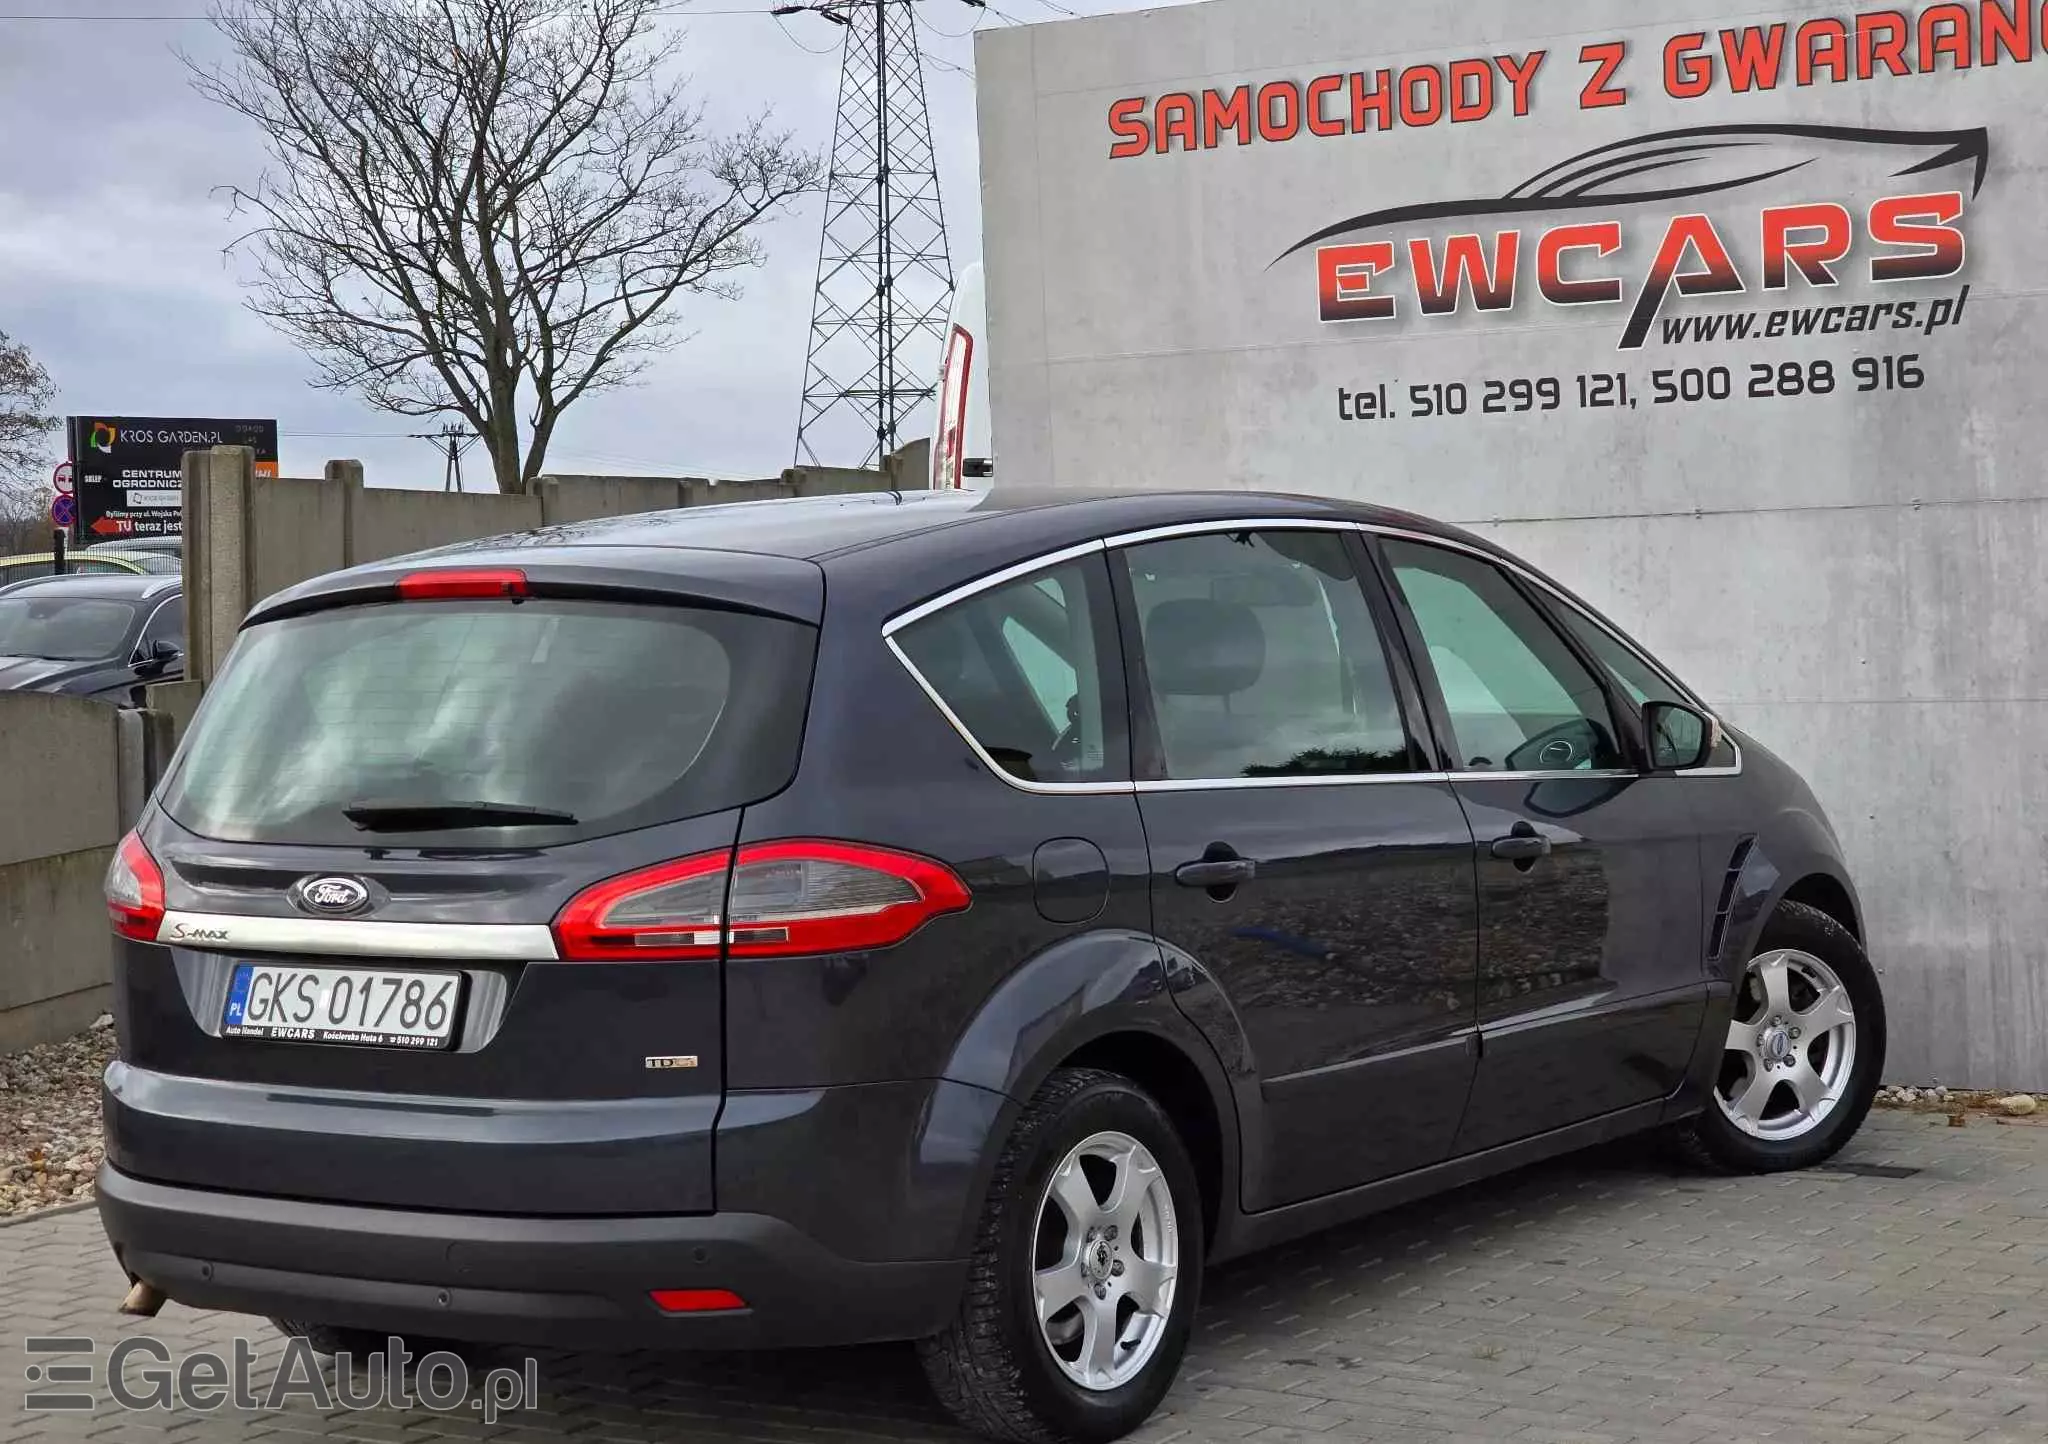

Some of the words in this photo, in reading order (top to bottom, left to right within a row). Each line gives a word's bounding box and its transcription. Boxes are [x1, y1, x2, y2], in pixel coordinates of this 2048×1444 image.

[1108, 50, 1547, 159] SAMOCHODY
[1578, 40, 1627, 110] Z
[1663, 0, 2048, 100] GWARAN
[1315, 191, 1966, 351] EWCARS
[1661, 284, 1971, 345] www.ewcars.pl
[1338, 385, 1395, 421] tel.
[1410, 383, 1467, 417] 510
[1482, 377, 1561, 413] 299
[1577, 372, 1637, 410] 121,
[1652, 366, 1732, 404] 500
[1748, 360, 1835, 398] 288
[1852, 354, 1925, 391] 916
[120, 430, 153, 443] KROS
[157, 430, 223, 444] GARDEN.PL
[122, 469, 182, 479] CENTRUM
[116, 520, 132, 532] TU
[134, 521, 162, 532] teraz
[163, 520, 182, 534] jest
[314, 884, 349, 905] Ford
[170, 922, 229, 940] S-MAX
[229, 1002, 243, 1017] PL
[247, 972, 320, 1023] GKS
[328, 975, 453, 1031] 01786
[226, 1025, 240, 1035] Auto
[271, 1026, 316, 1040] EWCARS
[410, 1036, 424, 1046] 299
[426, 1038, 438, 1047] 121
